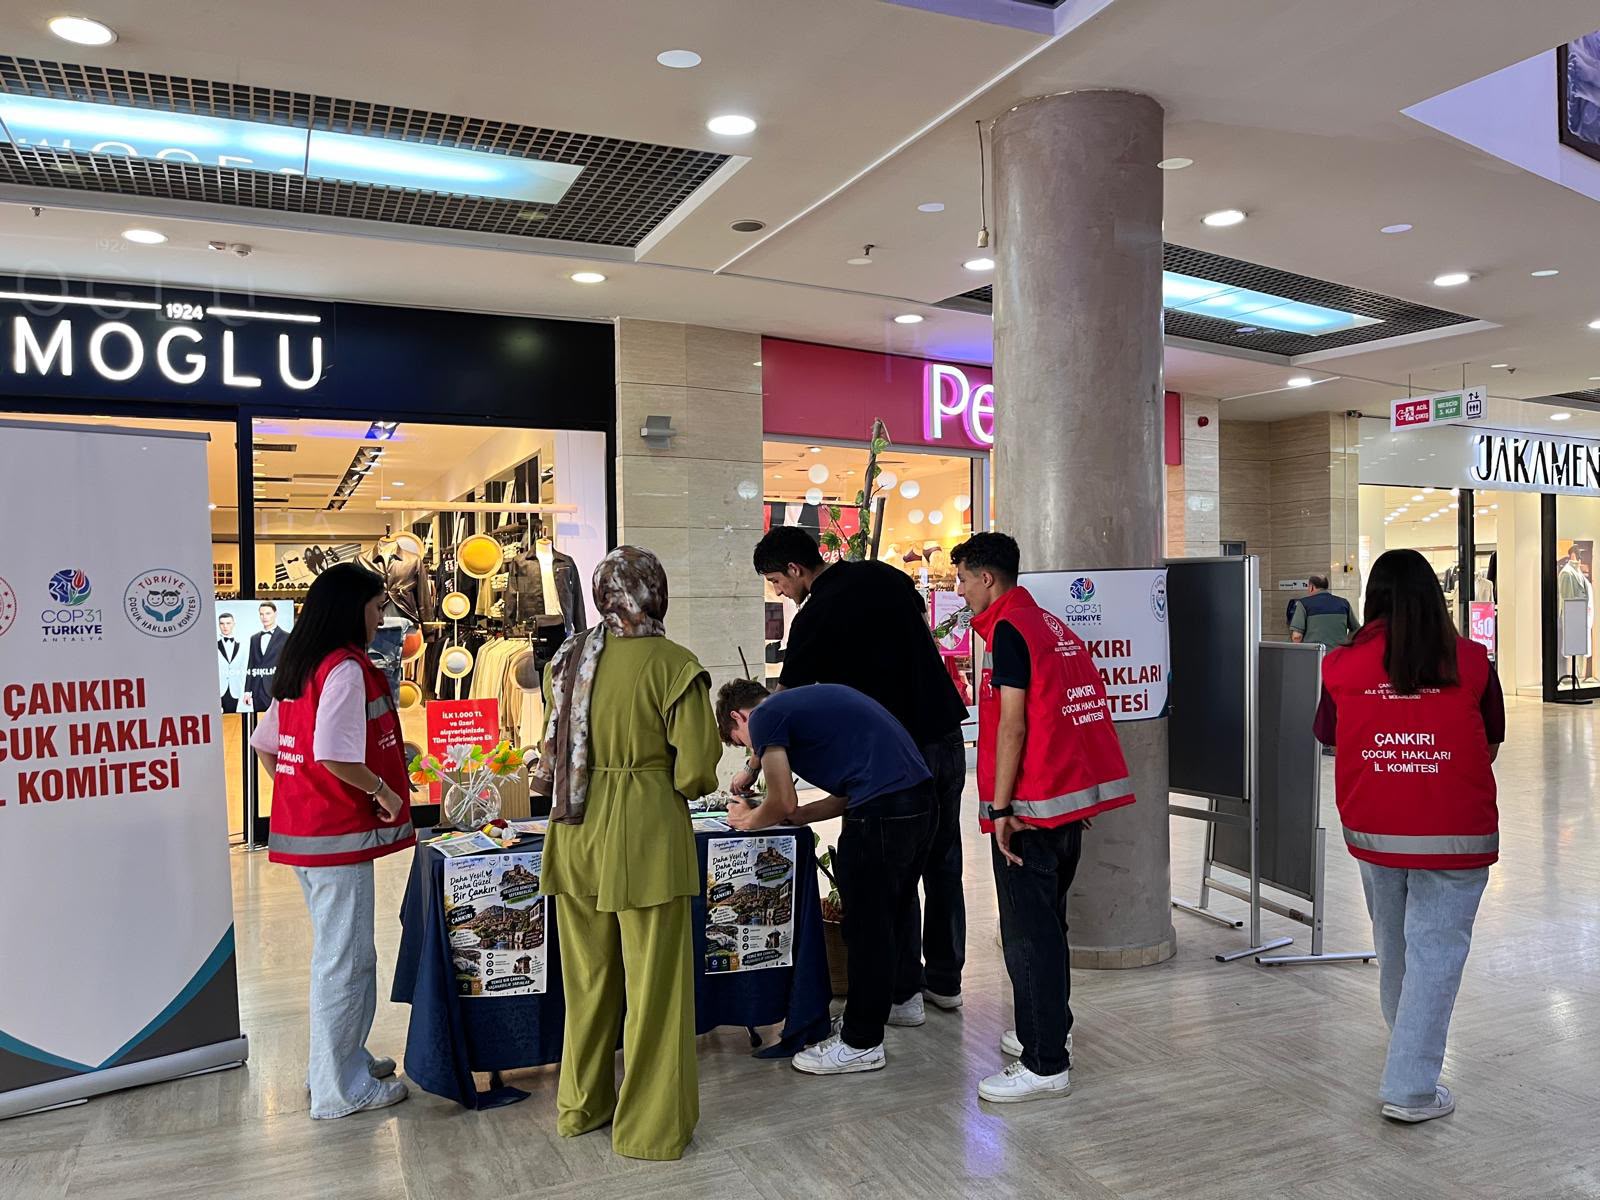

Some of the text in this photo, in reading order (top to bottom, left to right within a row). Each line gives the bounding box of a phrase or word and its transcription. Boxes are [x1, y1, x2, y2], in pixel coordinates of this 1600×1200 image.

[166, 302, 204, 320] 1924
[13, 315, 322, 390] MOGLU
[138, 575, 186, 590] TÜRKİYE
[41, 609, 102, 623] COP31
[128, 596, 196, 633] ÇOCUK HAKLARI KOMİTESİ
[1065, 604, 1102, 614] COP31
[42, 625, 102, 635] TÜRKİYE
[1083, 640, 1131, 658] KIRI
[3, 677, 146, 721] ÇANKIRI
[1066, 684, 1096, 702] ÇANKIRI
[442, 711, 453, 719] İLK
[1062, 703, 1082, 716] ÇOCUK
[69, 714, 211, 756] HAKLARI
[1374, 732, 1435, 747] ÇANKIRI
[1361, 749, 1451, 761] ÇOCUK HAKLARI
[1374, 761, 1439, 773] İL KOMİTESİ
[18, 751, 180, 804] KOMİTESİ
[713, 856, 728, 866] Daha
[715, 859, 748, 872] Daha Güzel
[450, 875, 468, 886] Daha
[715, 871, 726, 882] Bir
[728, 865, 753, 879] Çankırı
[453, 877, 492, 893] Daha Güzel
[453, 891, 465, 904] Bir
[468, 886, 498, 902] Çankırı
[451, 912, 473, 925] ÇANKIRI
